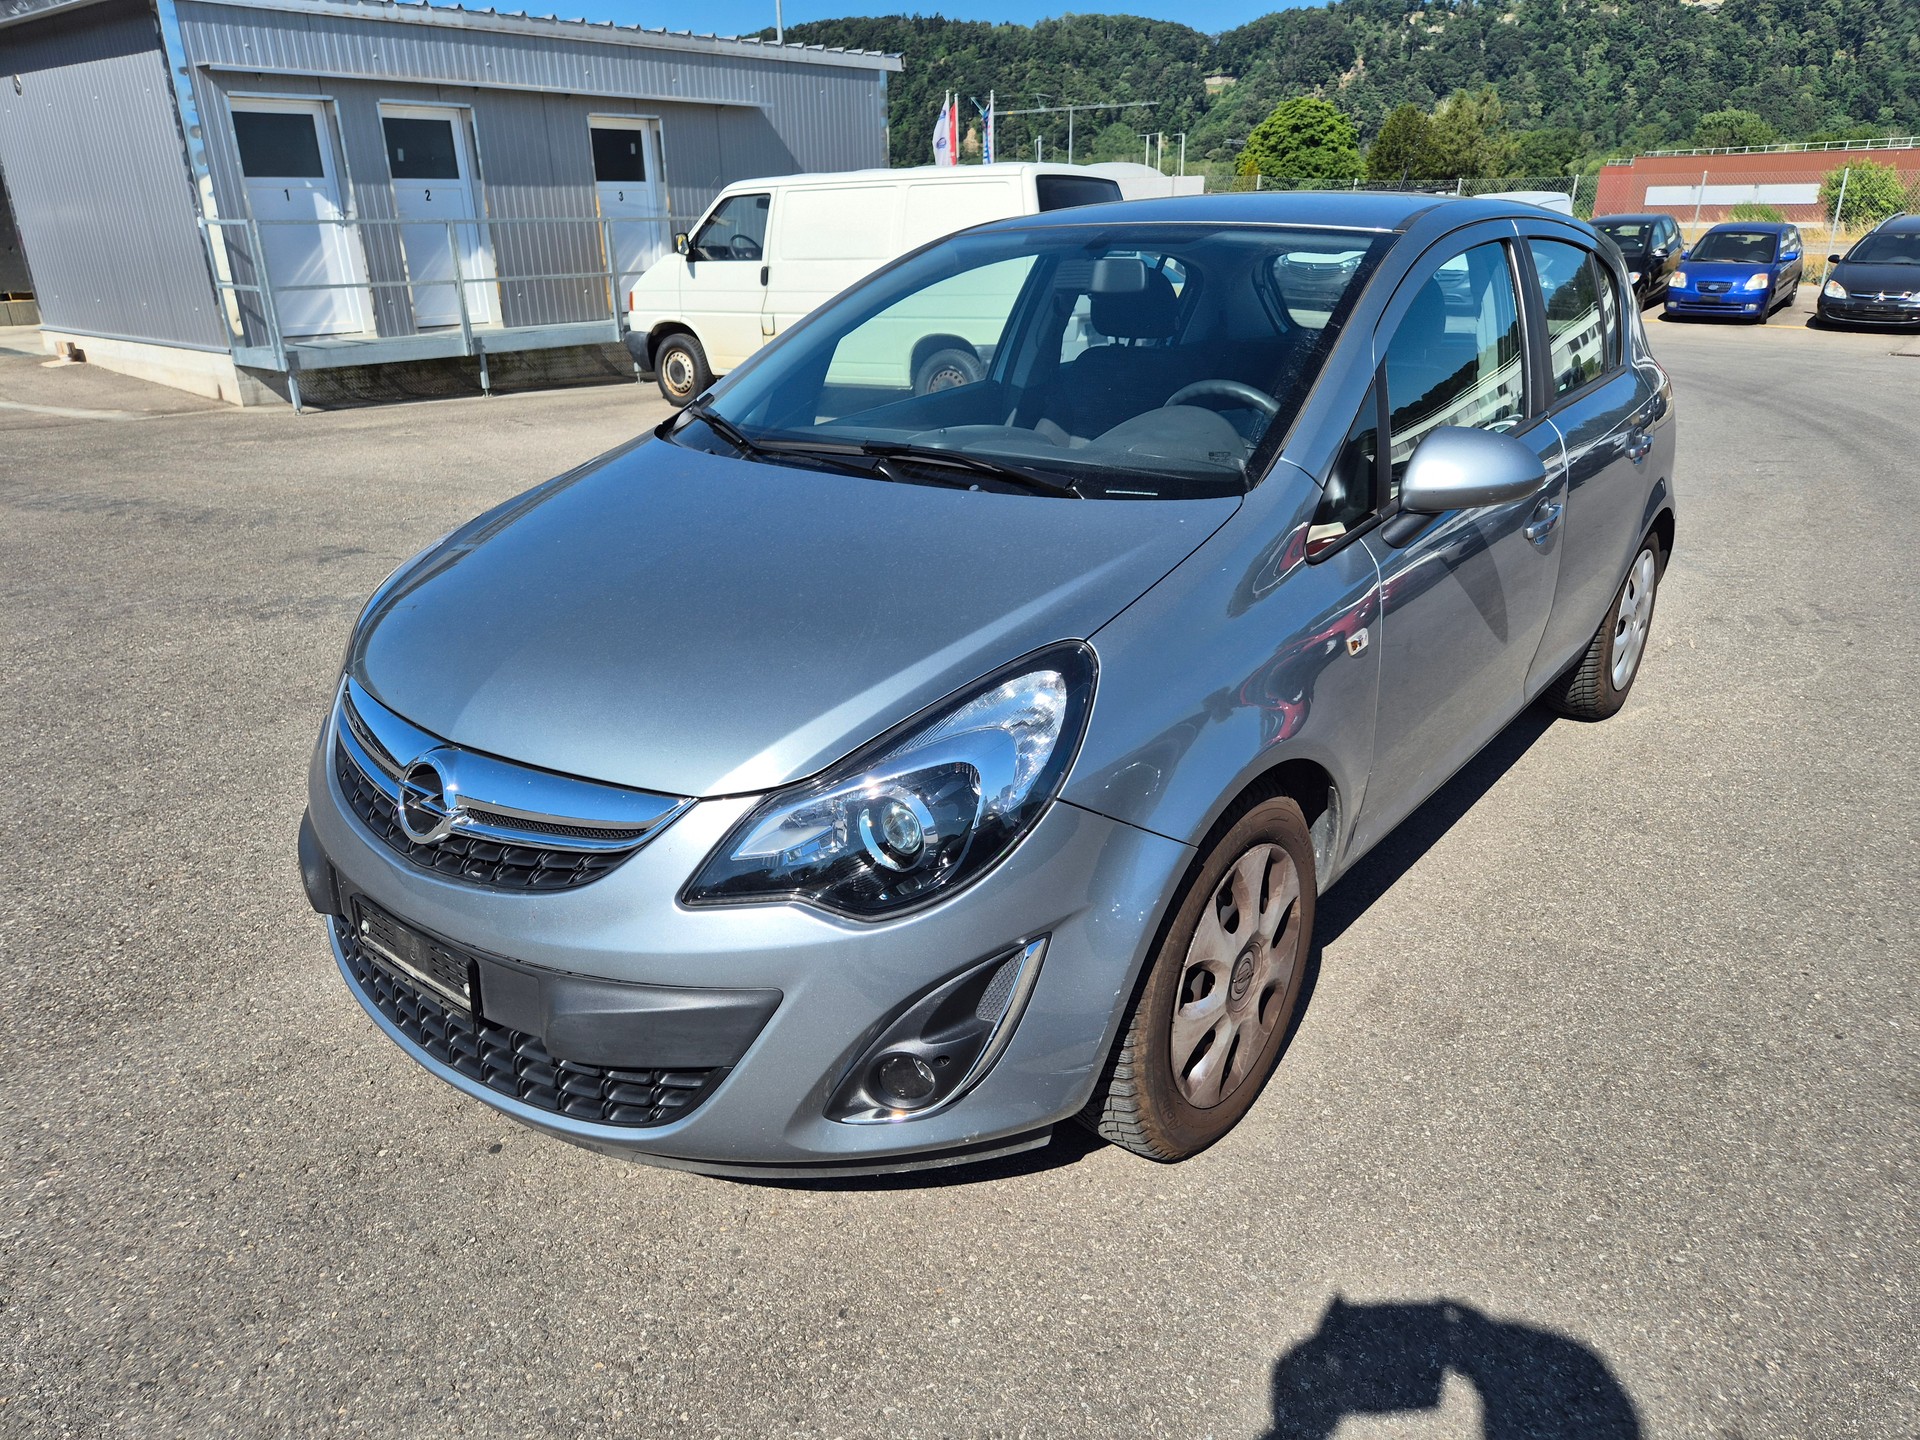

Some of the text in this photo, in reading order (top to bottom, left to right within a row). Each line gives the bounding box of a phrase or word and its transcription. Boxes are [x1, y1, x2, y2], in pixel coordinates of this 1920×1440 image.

[284, 189, 290, 201] 1
[425, 189, 432, 201] 2
[618, 191, 624, 202] 3
